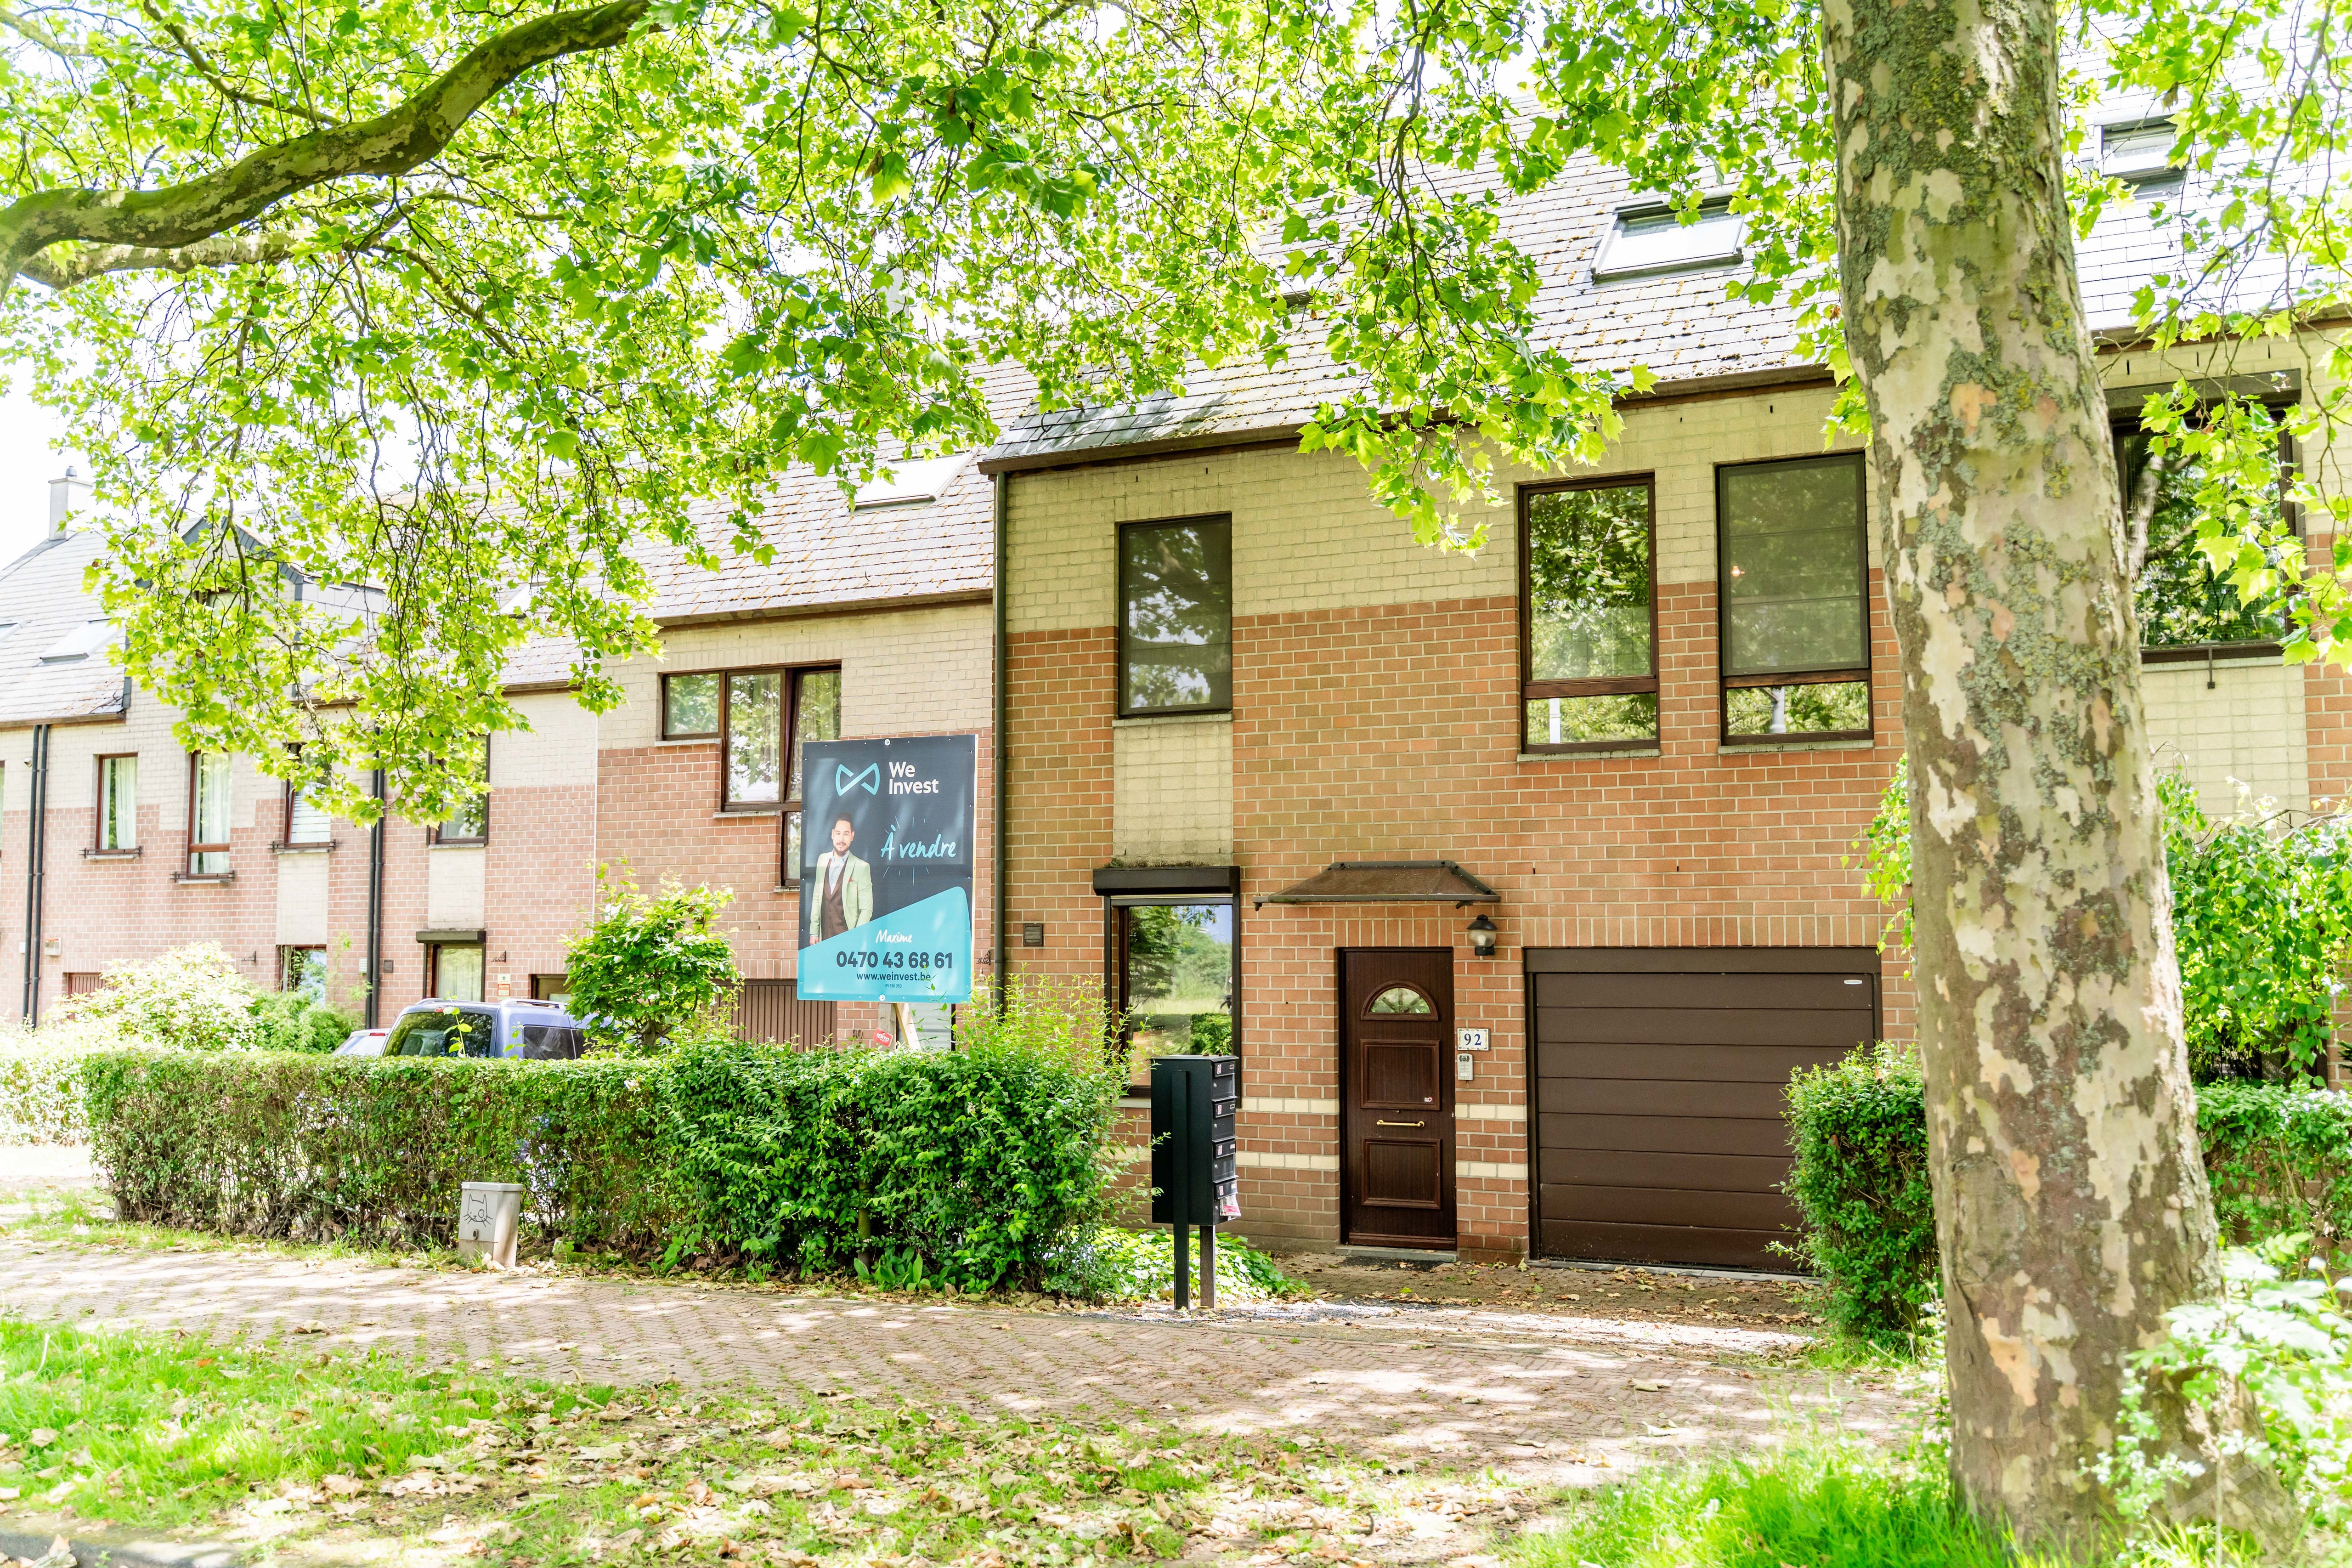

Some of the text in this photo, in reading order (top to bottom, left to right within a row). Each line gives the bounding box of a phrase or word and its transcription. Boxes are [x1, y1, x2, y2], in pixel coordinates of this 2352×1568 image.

[889, 762, 915, 778] We
[889, 779, 939, 794] Invest
[881, 824, 956, 860] À vendre
[876, 929, 912, 943] Maxime
[837, 951, 952, 968] 0470 43 68 61
[856, 972, 931, 981] www.weinvest.be
[1464, 1033, 1481, 1046] 92
